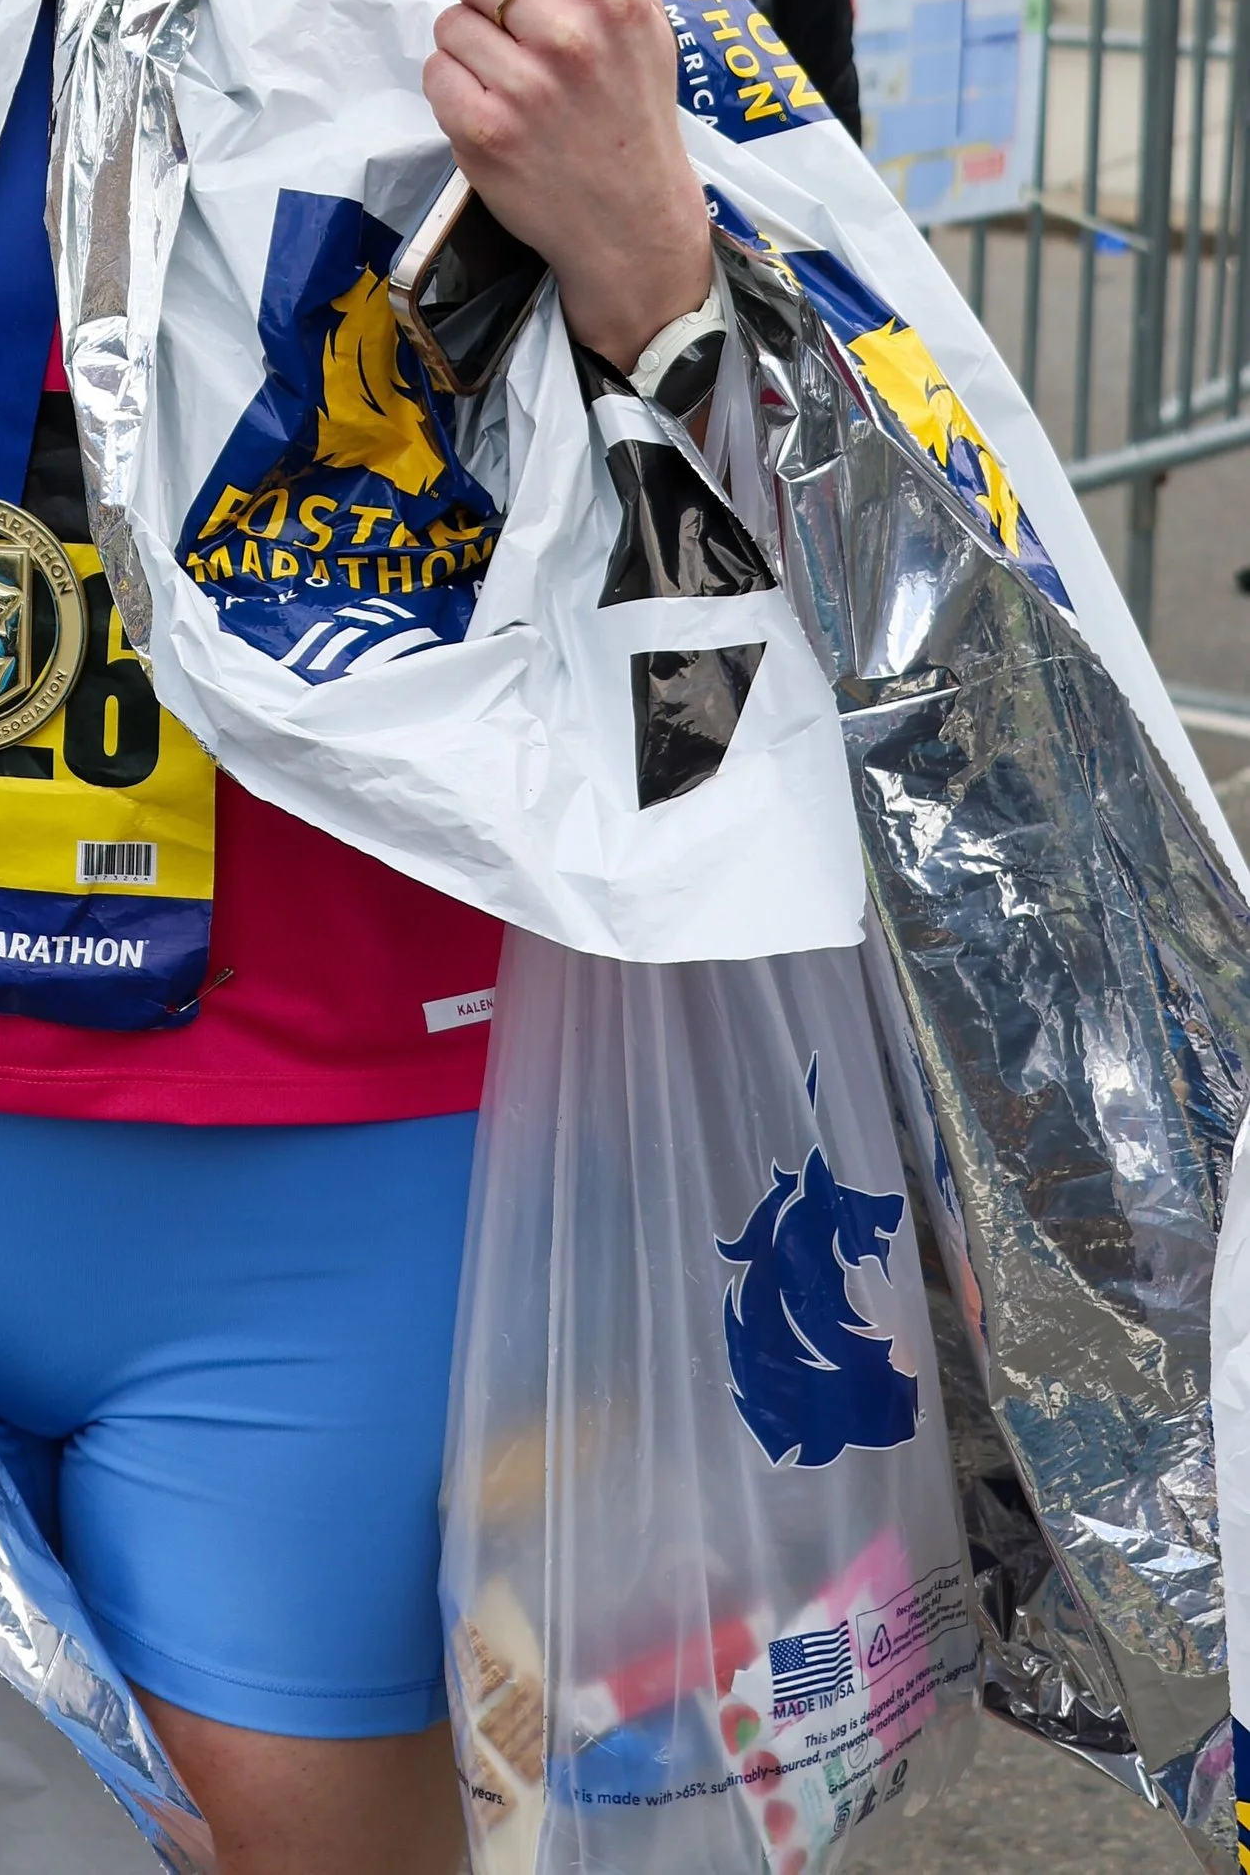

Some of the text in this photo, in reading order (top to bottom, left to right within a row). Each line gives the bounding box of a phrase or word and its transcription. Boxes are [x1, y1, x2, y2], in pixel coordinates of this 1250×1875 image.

[773, 1701, 815, 1720] MADE
[819, 1695, 833, 1709] IN
[805, 1734, 828, 1748] This
[830, 1724, 847, 1741] bag
[850, 1717, 858, 1730] is
[860, 1690, 894, 1726] designed
[896, 1688, 904, 1699] to
[906, 1680, 914, 1692] be
[582, 1789, 593, 1803] is
[597, 1791, 640, 1805] made
[646, 1788, 672, 1805] with
[675, 1782, 706, 1800] >65%
[711, 1752, 822, 1794] susainably-sourced,
[825, 1728, 874, 1760] renewable
[875, 1699, 910, 1732] materials
[911, 1685, 925, 1705] and
[471, 1785, 505, 1806] years.
